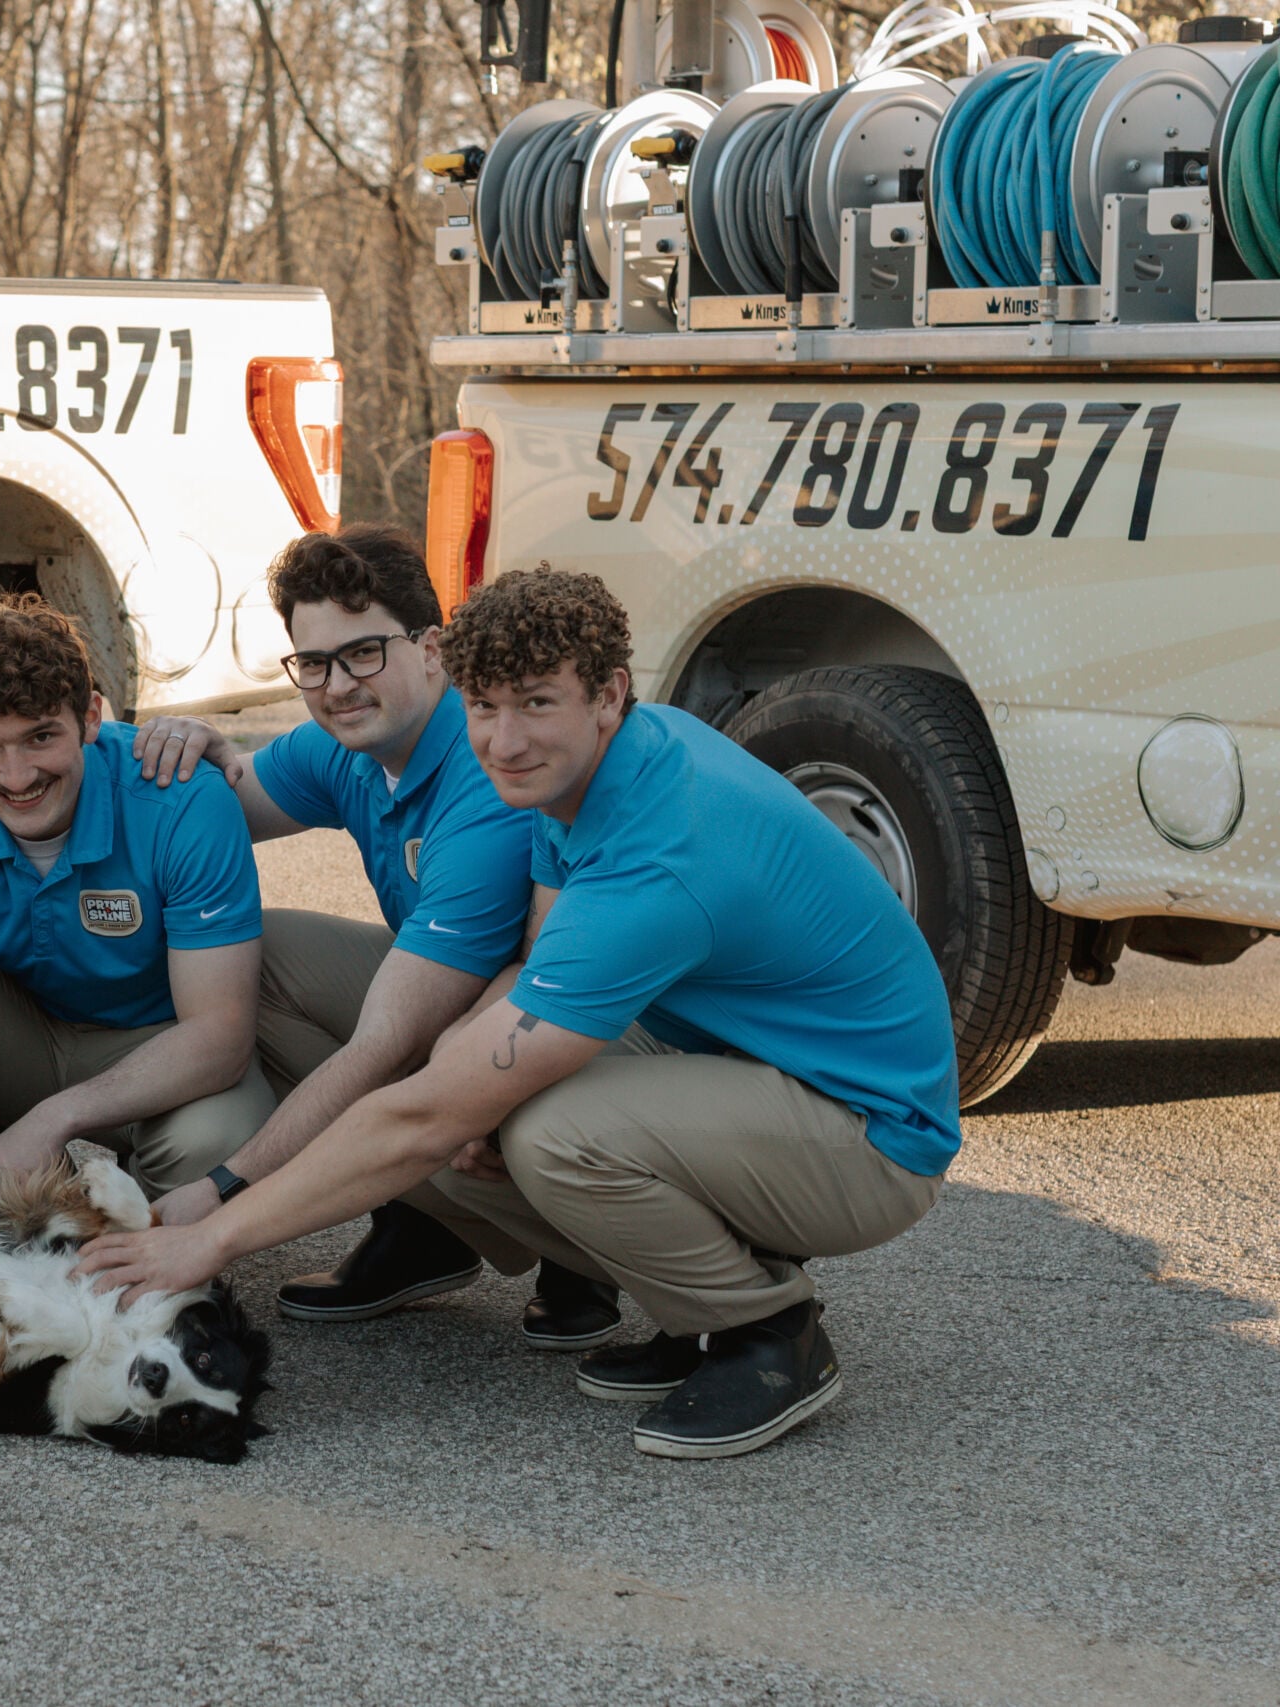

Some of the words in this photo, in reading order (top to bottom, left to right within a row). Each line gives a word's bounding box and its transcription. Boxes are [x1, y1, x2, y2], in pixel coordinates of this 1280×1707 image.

[756, 304, 787, 322] Kings
[1004, 296, 1039, 316] Kings
[587, 403, 1182, 541] 574.780.8371
[87, 899, 130, 910] PRIME
[89, 910, 132, 922] SHINE
